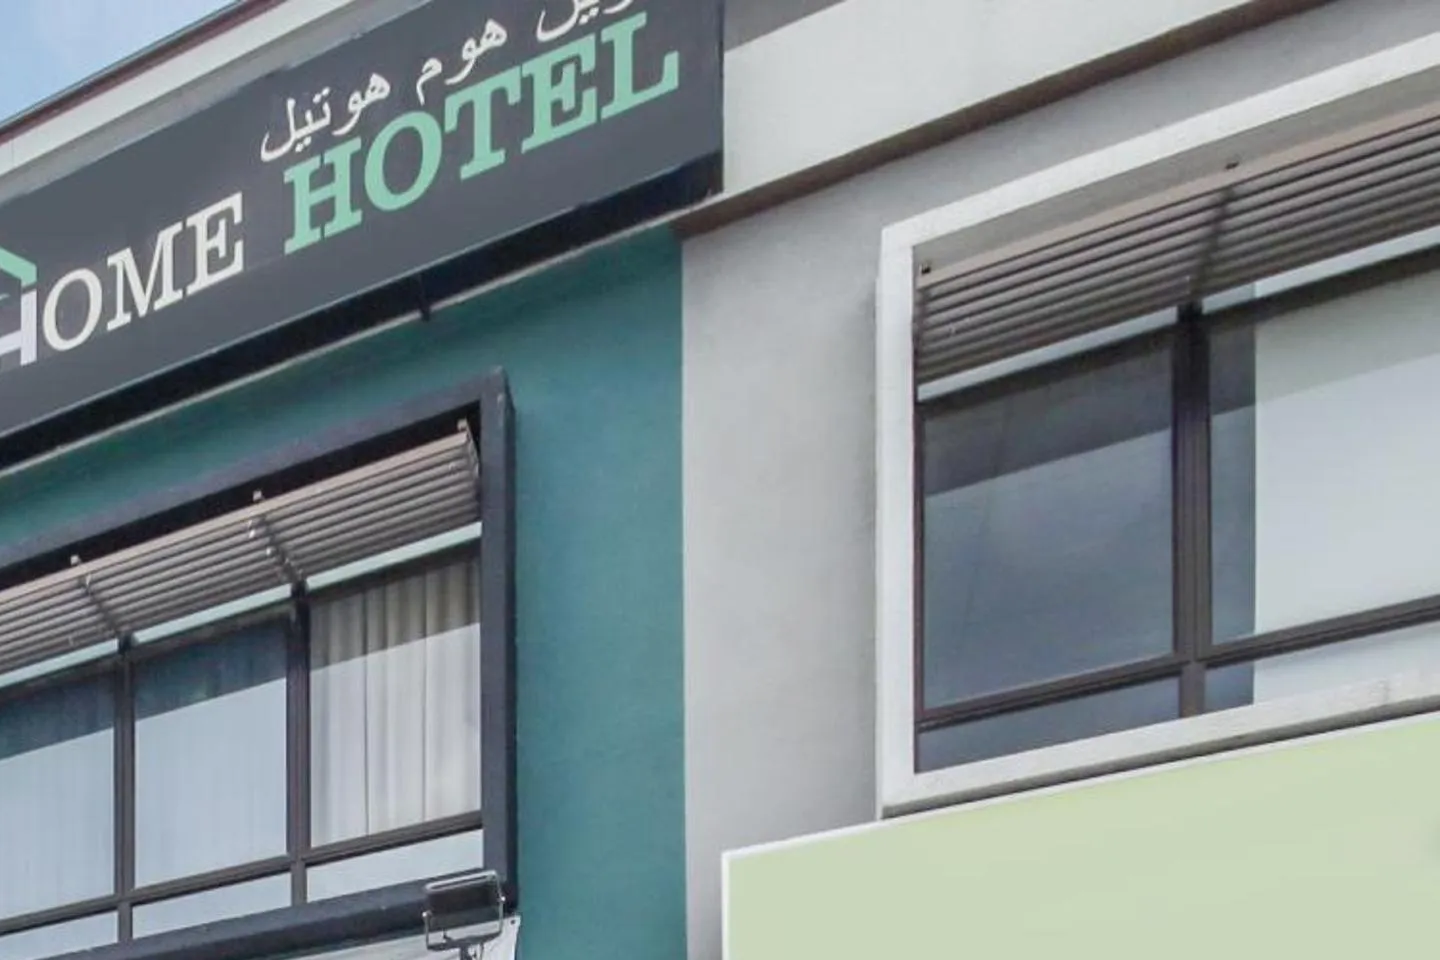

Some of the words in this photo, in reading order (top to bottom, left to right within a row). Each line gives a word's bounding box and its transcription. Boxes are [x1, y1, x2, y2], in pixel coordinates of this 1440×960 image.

[416, 18, 507, 105] هوم
[260, 72, 391, 162] هوتيل
[284, 12, 679, 255] HOTEL
